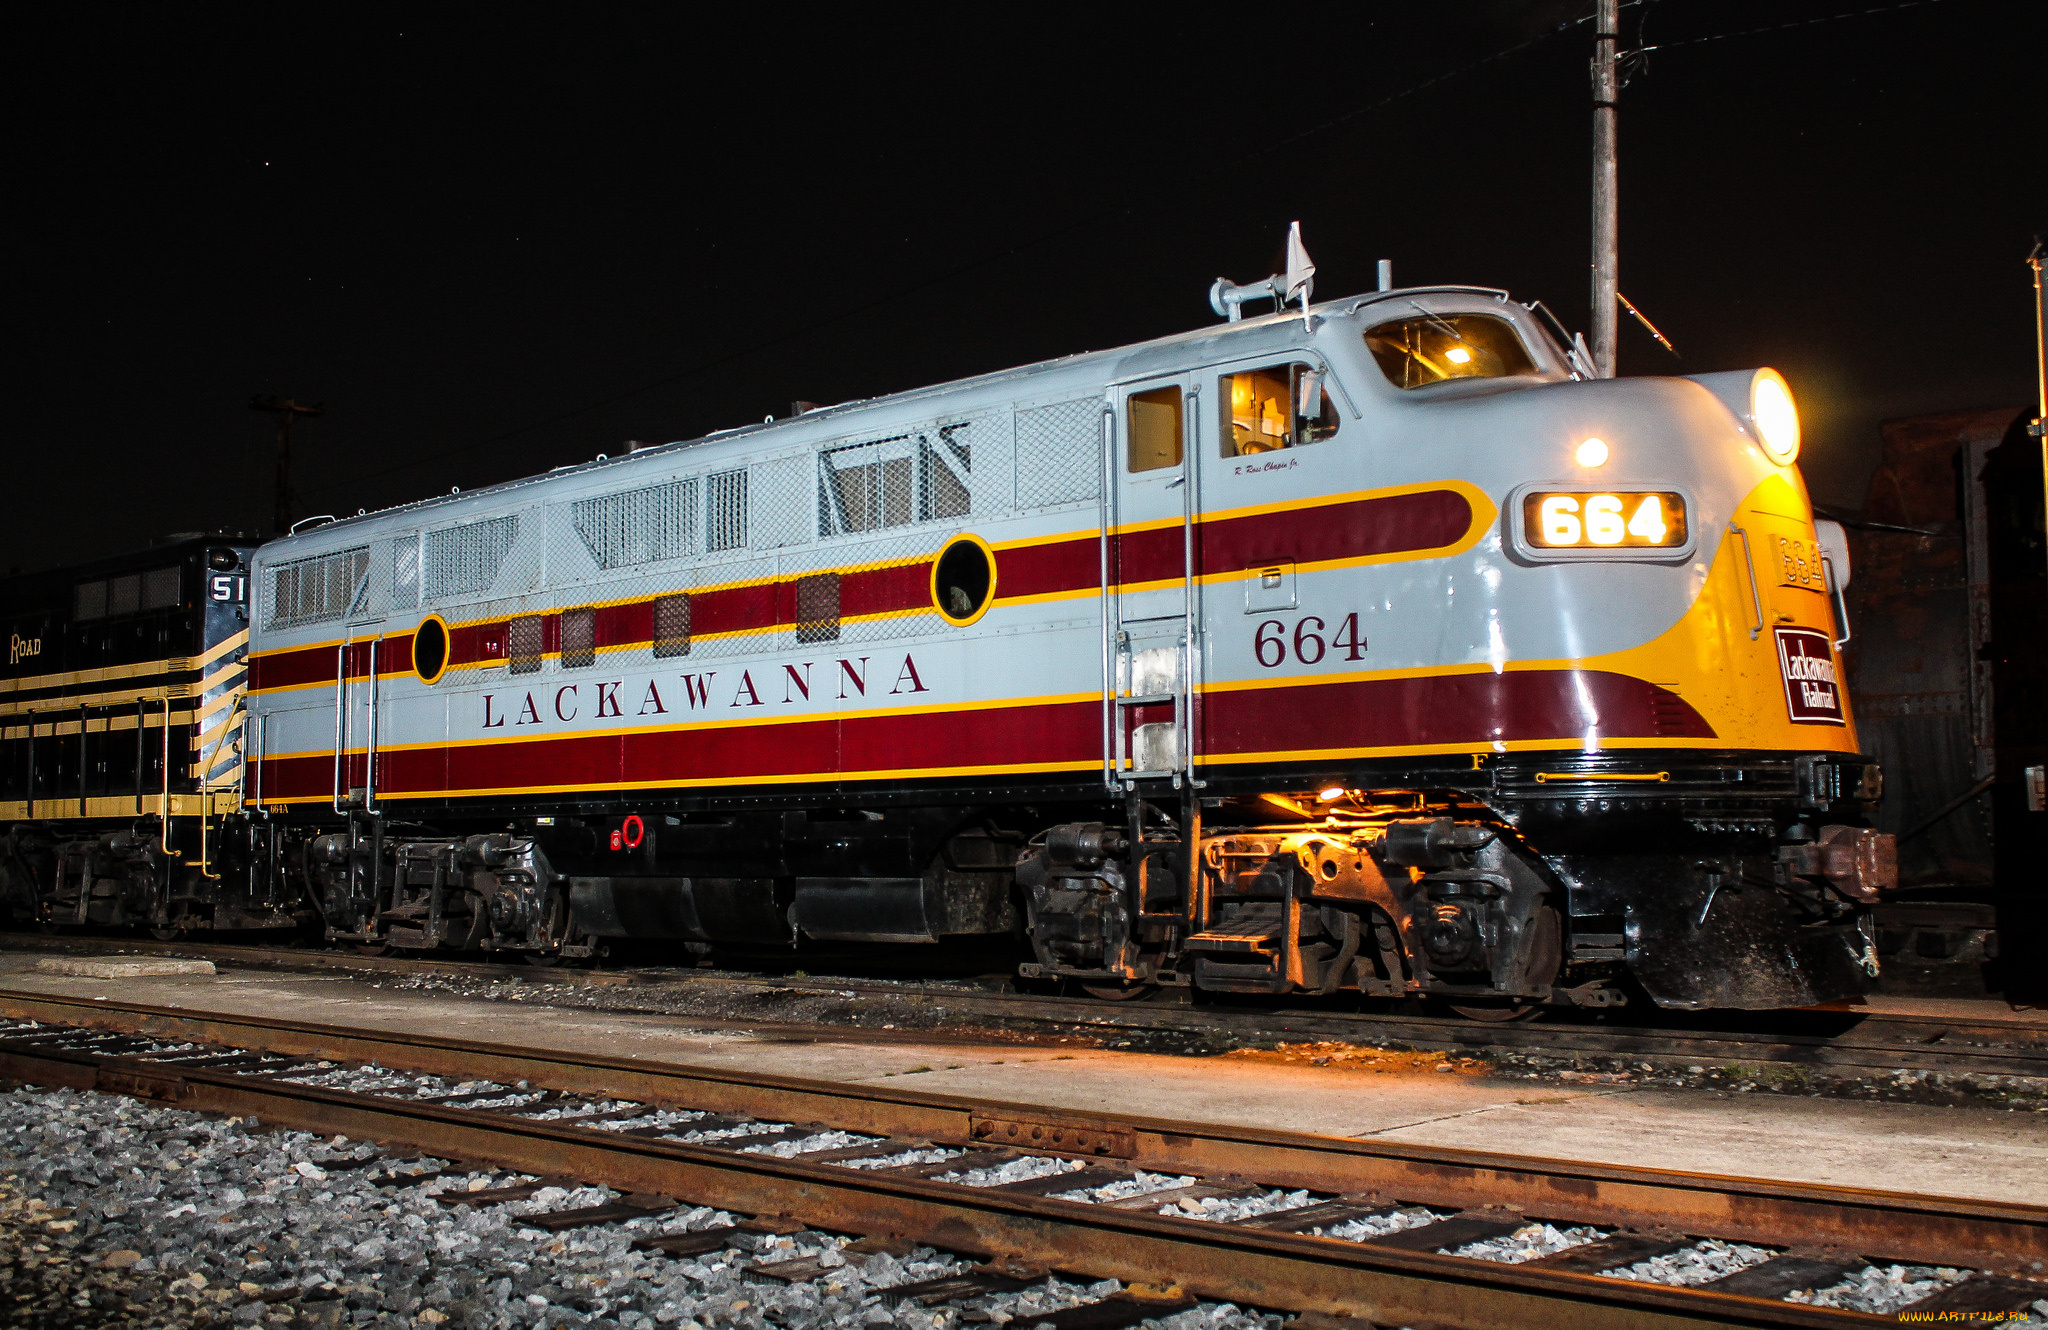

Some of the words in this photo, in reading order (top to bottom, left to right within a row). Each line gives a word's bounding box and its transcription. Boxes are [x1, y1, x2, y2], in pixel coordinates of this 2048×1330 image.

[1541, 495, 1667, 545] 664
[1254, 612, 1369, 668] 664
[482, 652, 930, 729] LACKAWANNA
[1800, 681, 1836, 709] Railroad
[1471, 753, 1489, 770] F
[270, 804, 289, 814] 664A
